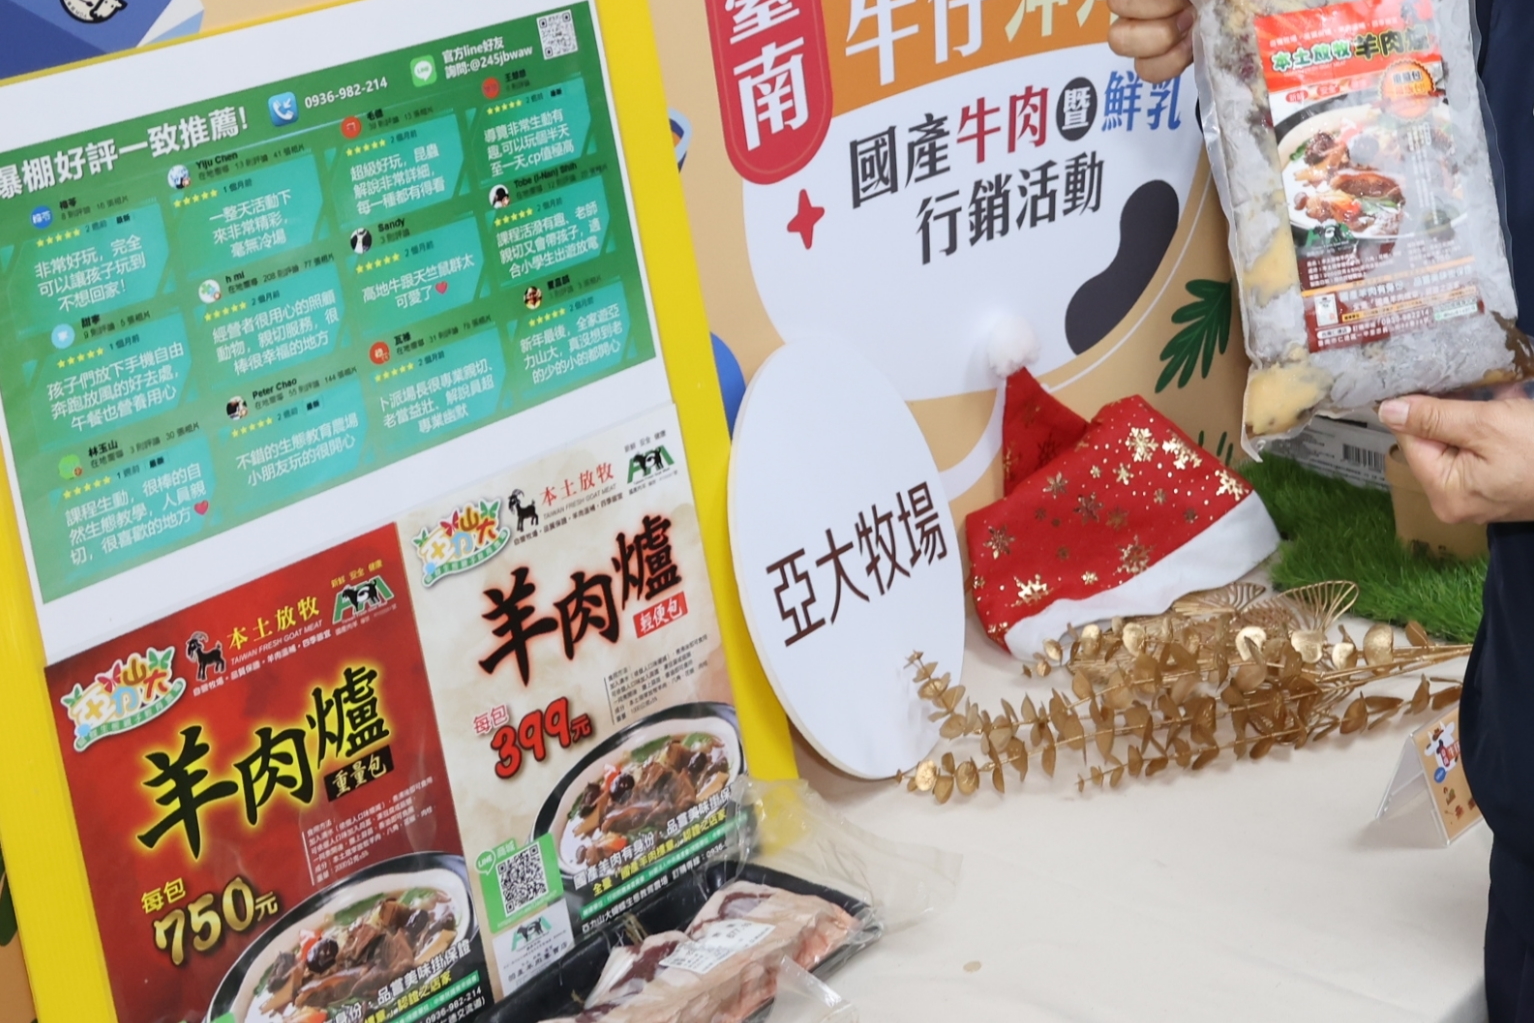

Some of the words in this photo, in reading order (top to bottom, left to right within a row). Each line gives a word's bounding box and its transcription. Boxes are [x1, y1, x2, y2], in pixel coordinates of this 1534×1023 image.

[442, 37, 504, 62] 官方line好友
[1272, 40, 1351, 72] 本土放牧
[304, 76, 388, 109] 0936-982-214
[209, 189, 291, 222] 一整天活動下
[378, 218, 405, 233] Sandy
[916, 150, 1105, 265] 行銷活動
[231, 228, 287, 258] 毫無冷場
[509, 236, 599, 279] 合小學生出遊放電
[38, 252, 146, 298] 可以讓孩子玩到
[362, 253, 475, 303] 高地牛跟天竺鼠群太
[395, 284, 433, 310] 可愛了
[212, 289, 336, 344] 經營者很用心的照顧
[47, 341, 184, 401] 孩子們放下手機自由
[234, 330, 328, 376] 棒很幸福的地方
[71, 385, 177, 432] 午餐也營養用心
[252, 384, 274, 399] Peter
[276, 378, 297, 392] Chao
[418, 403, 469, 433] 專業幽默
[236, 412, 359, 470] 不錯的生態教育農場
[247, 435, 356, 487] 小朋友玩的很開心
[540, 461, 614, 506] 本土放牧
[543, 507, 565, 520] TAIWAN
[566, 499, 585, 511] FRESH
[586, 491, 601, 503] GOAT
[601, 483, 617, 495] MEAT
[766, 481, 947, 647] 亞大牧場
[478, 514, 682, 687] 羊肉爐
[227, 596, 320, 651] 本土放牧
[231, 649, 258, 666] TAIWAN
[258, 638, 283, 655] FRESH
[284, 629, 304, 643] GOAT
[304, 619, 323, 635] MEAT
[473, 705, 509, 735] 每包
[491, 697, 592, 778] 399元
[138, 667, 389, 859] 羊肉爐
[331, 755, 387, 799] 重量包
[478, 856, 493, 868] LINE
[141, 878, 186, 914] 每包
[153, 878, 278, 965] 750元
